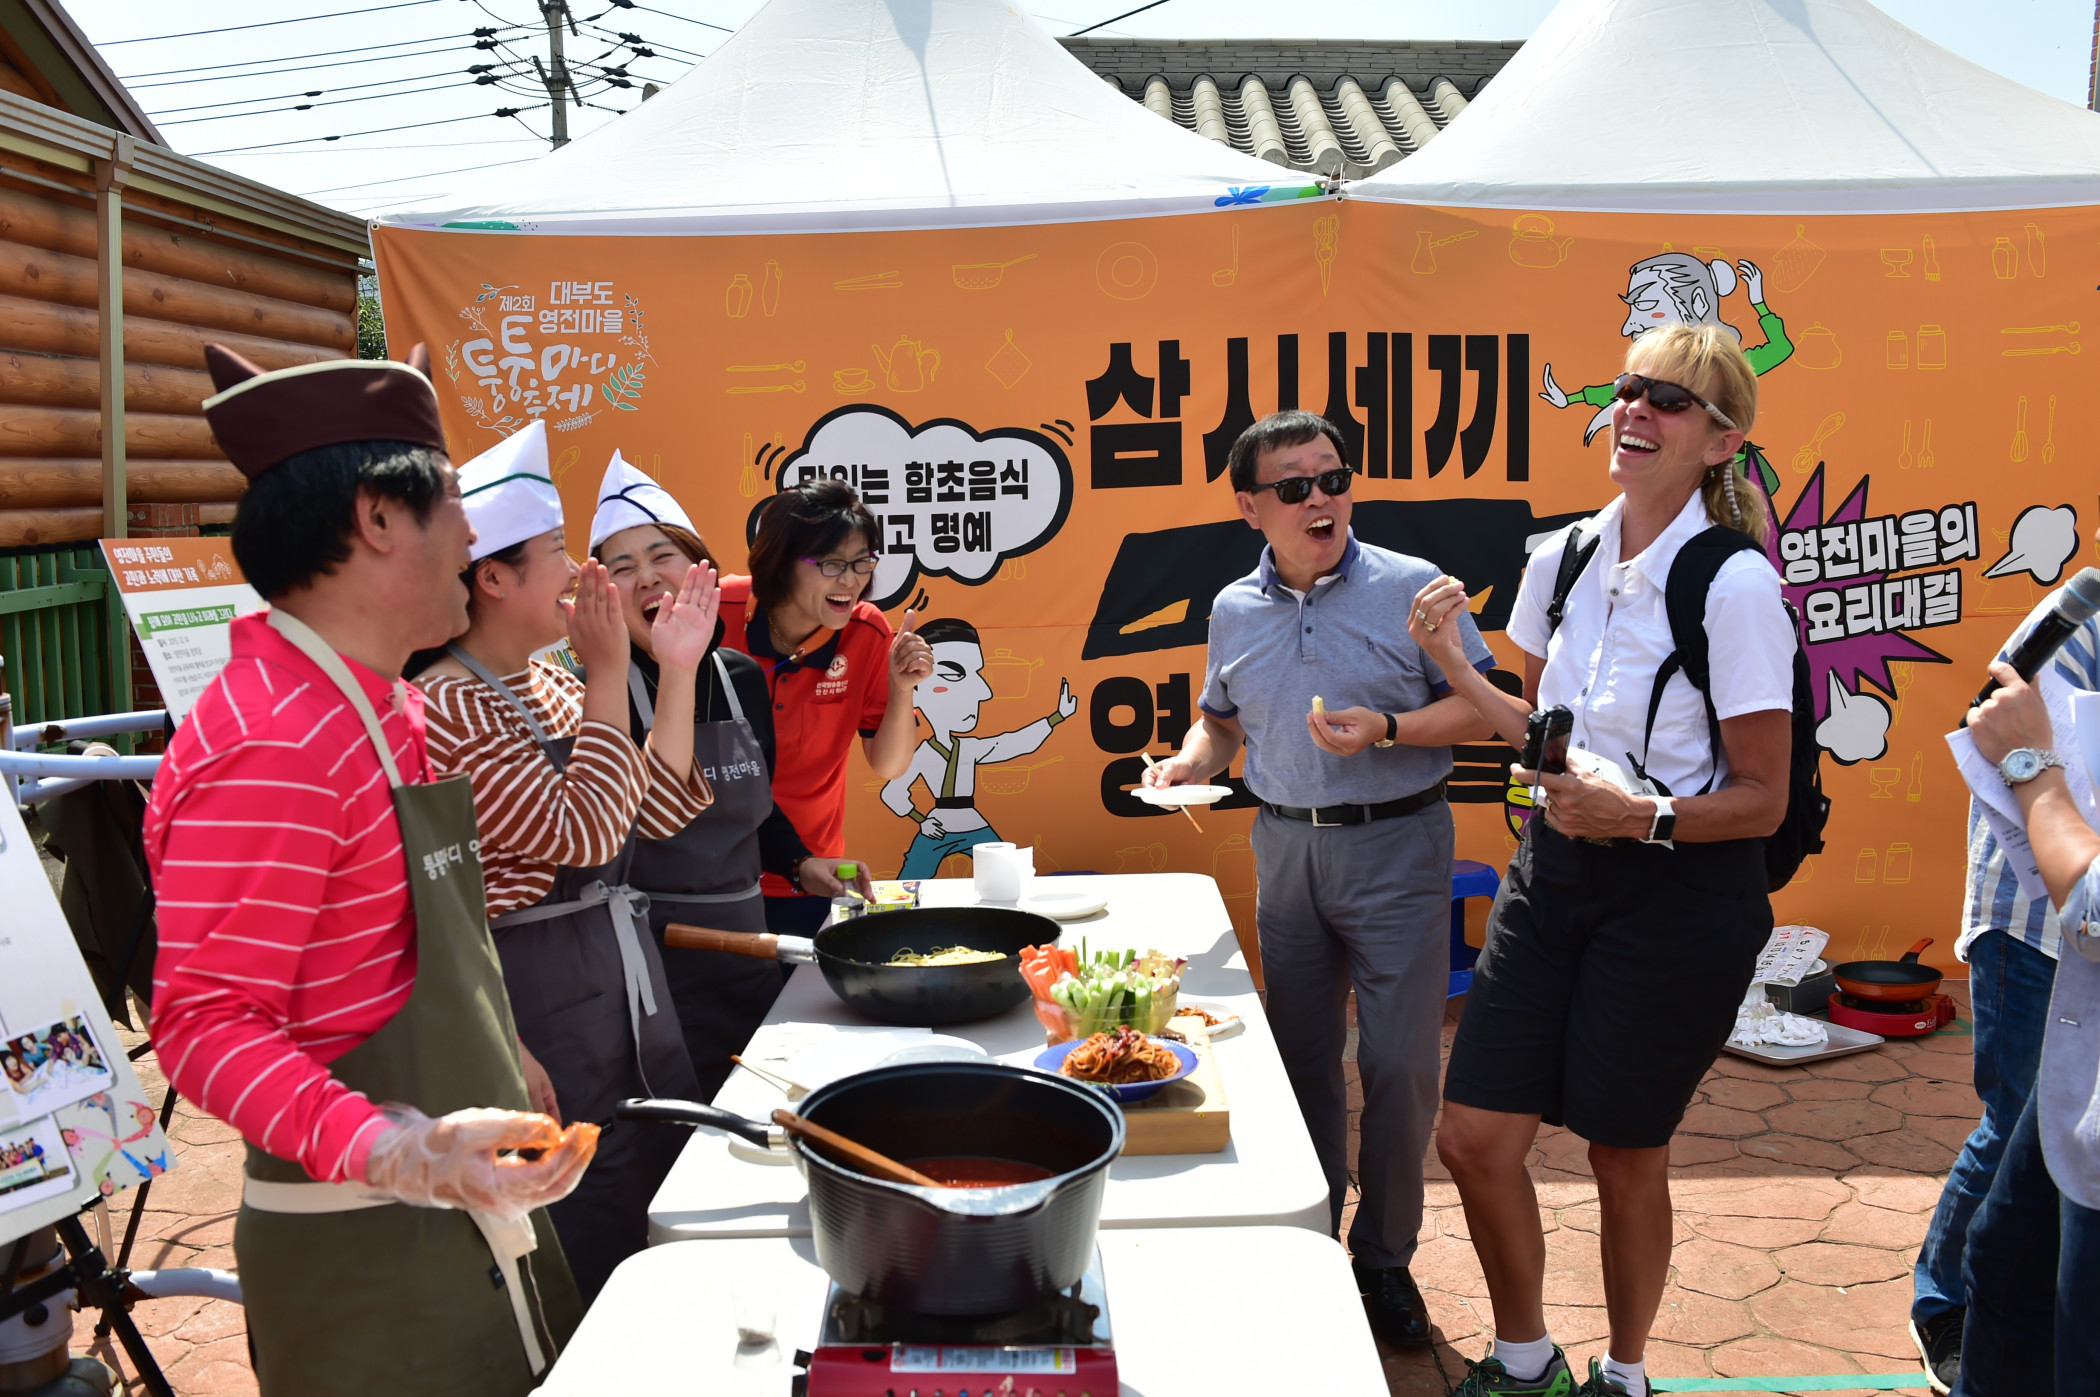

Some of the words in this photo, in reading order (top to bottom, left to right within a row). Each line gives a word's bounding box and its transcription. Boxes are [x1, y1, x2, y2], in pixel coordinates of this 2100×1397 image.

[499, 295, 535, 312] 제2회
[549, 281, 614, 305] 대부도
[538, 309, 624, 334] 영전마을
[1085, 332, 1529, 490] 삼시세끼
[905, 459, 1029, 503] 함초음식
[931, 511, 992, 554] 명예
[1780, 504, 1978, 584] 영전마을의
[113, 546, 147, 564] 영전마을
[143, 545, 174, 563] 주민들의
[123, 569, 147, 587] 고민과
[145, 568, 170, 585] 노력에
[167, 567, 186, 584] 대한
[182, 566, 200, 582] 기록
[1806, 571, 1959, 643] 요리대결
